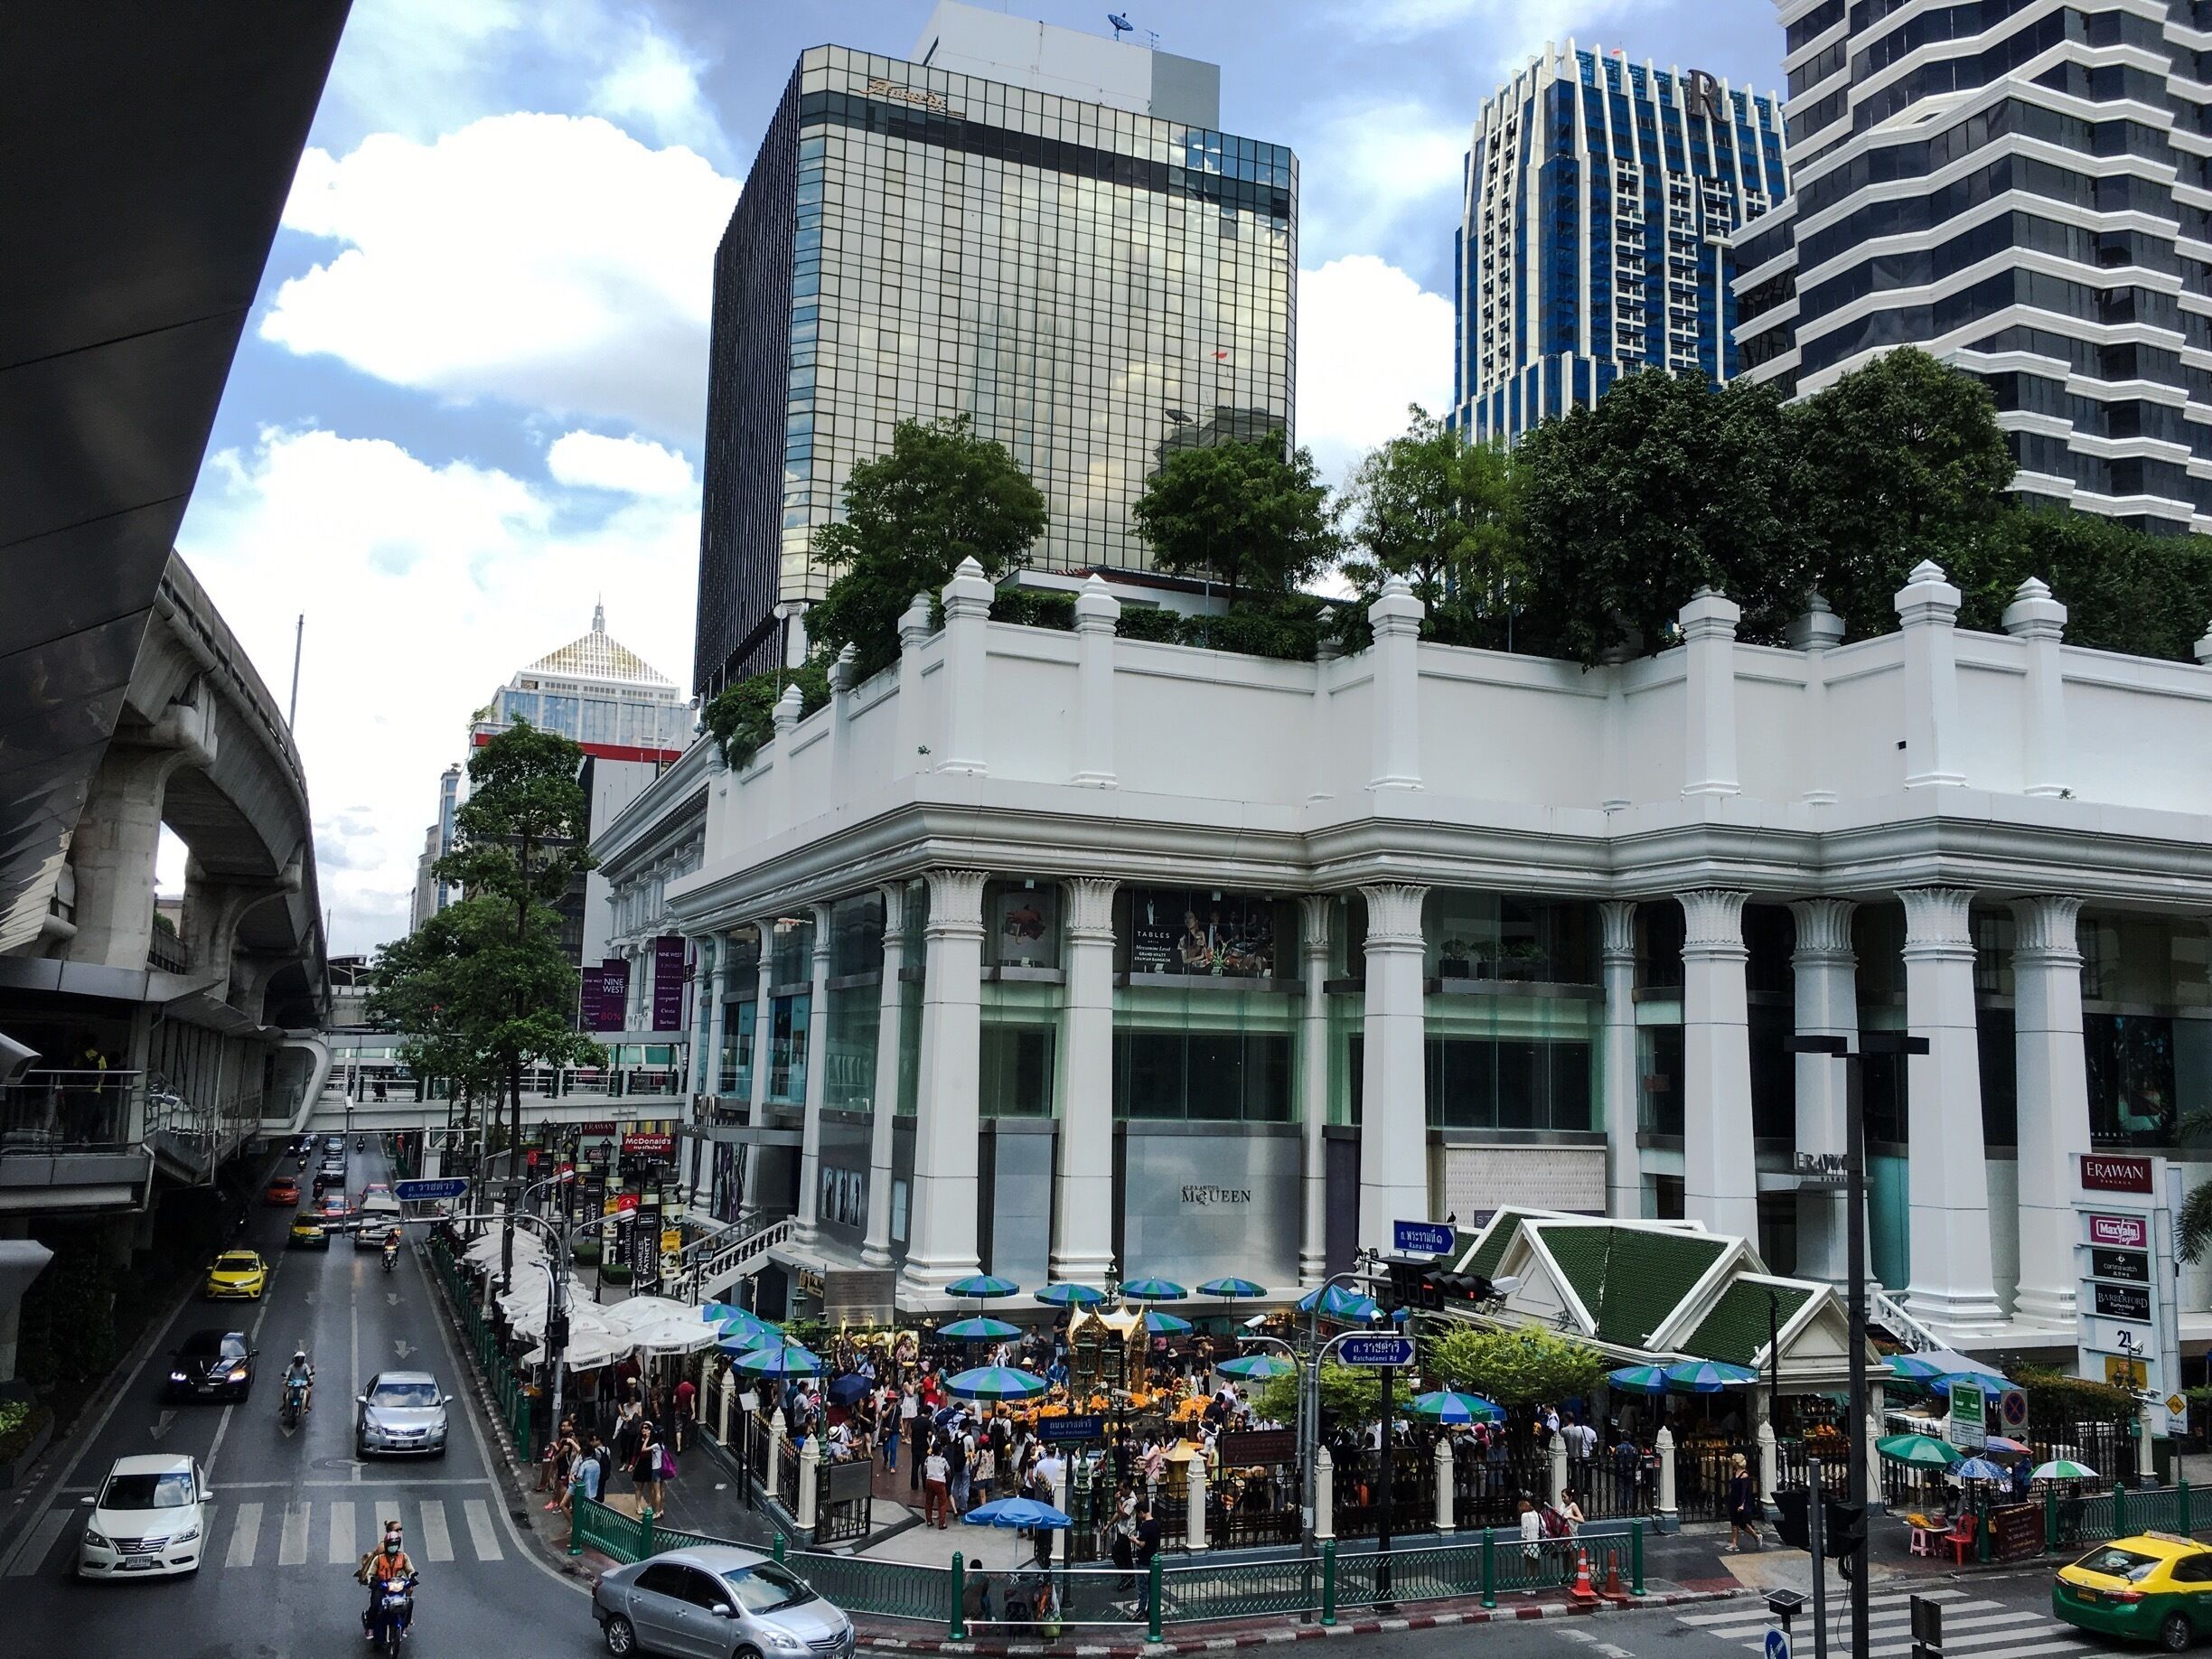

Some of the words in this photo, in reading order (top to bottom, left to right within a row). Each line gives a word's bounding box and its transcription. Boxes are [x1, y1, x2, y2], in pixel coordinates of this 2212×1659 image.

[1687, 69, 1731, 123] R
[1137, 931, 1170, 939] TABLES
[603, 986, 625, 994] WEST
[604, 978, 623, 986] NINE
[1794, 1152, 1847, 1172] ERAW
[2086, 1161, 2144, 1180] ERAWAN
[2099, 1219, 2136, 1236] MaxValu
[642, 1235, 651, 1275] PATNETT
[2098, 1292, 2148, 1308] BARBERFORD
[2117, 1330, 2132, 1347] 21
[1303, 1518, 1308, 1526] 8
